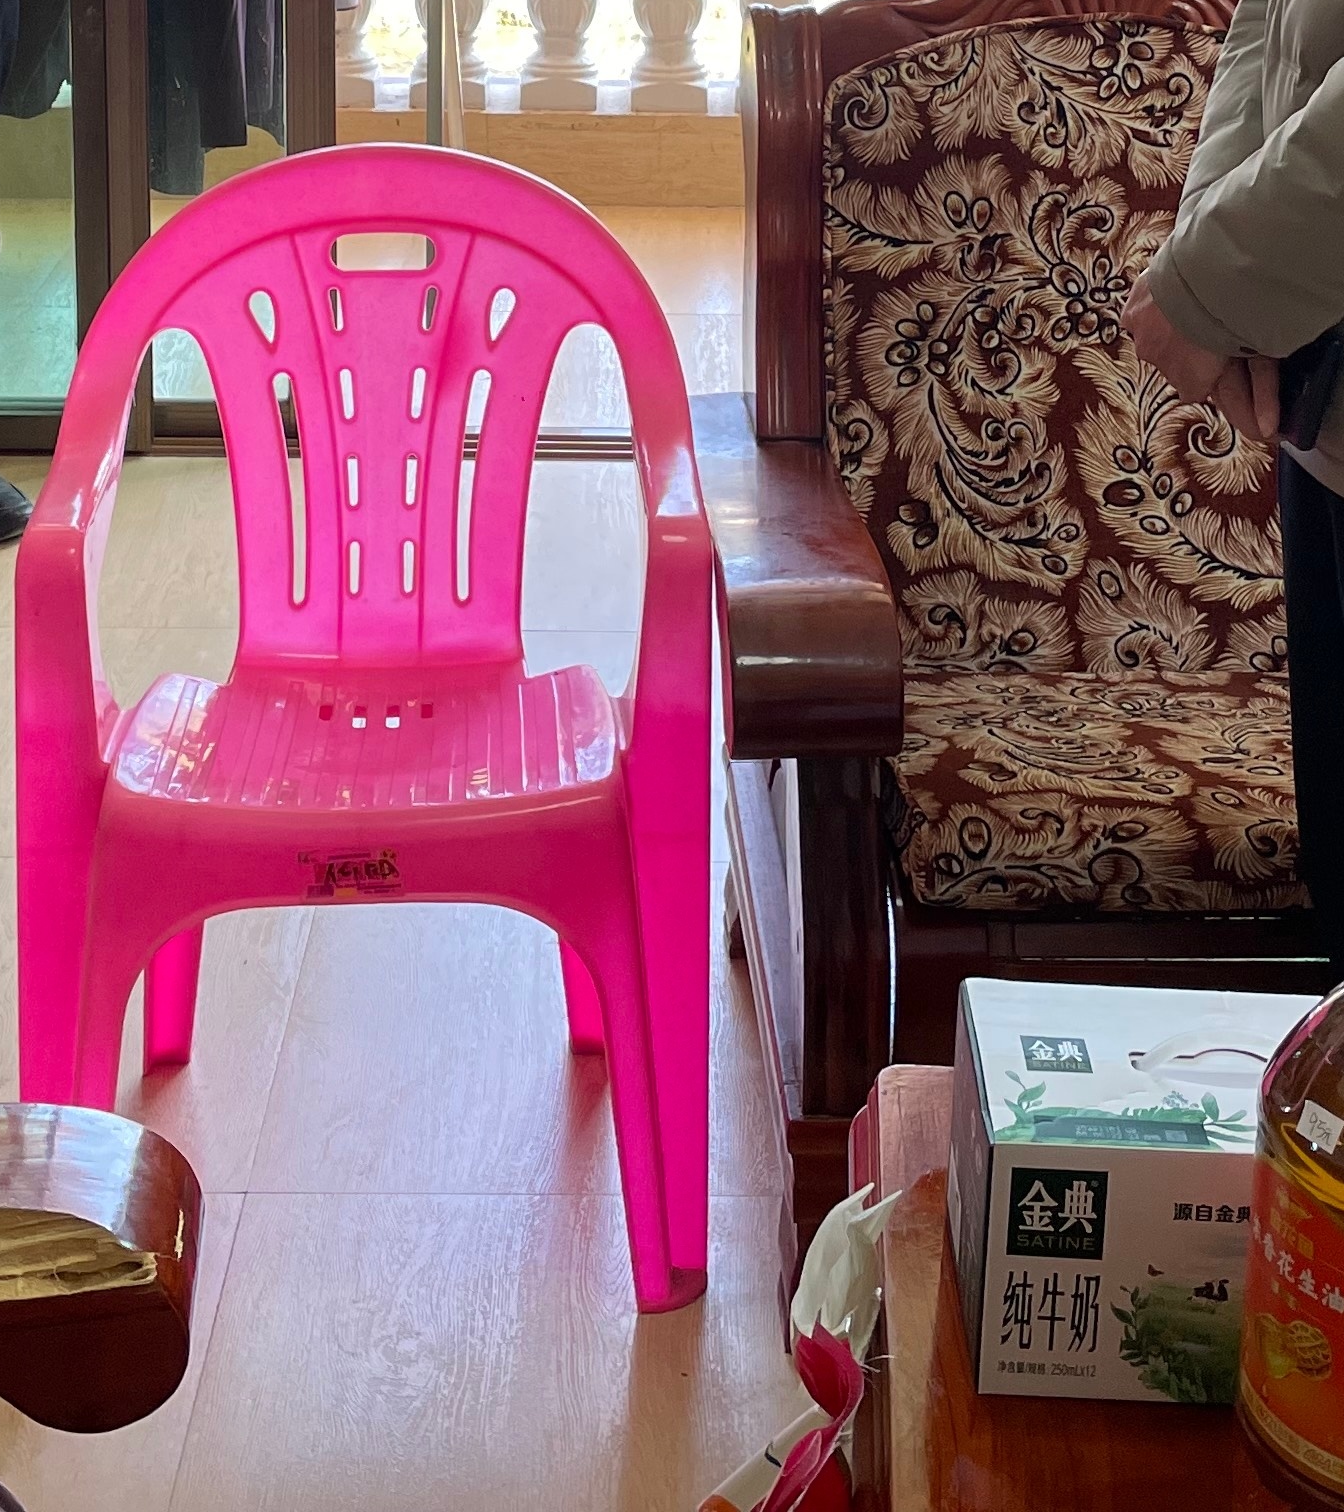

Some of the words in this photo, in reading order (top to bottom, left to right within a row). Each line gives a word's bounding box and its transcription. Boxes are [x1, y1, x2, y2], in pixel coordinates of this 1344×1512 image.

[1028, 1039, 1084, 1062] 金典
[1017, 1179, 1097, 1233] 金典
[1016, 1233, 1096, 1251] SATINE
[1000, 1270, 1101, 1353] 纯牛奶
